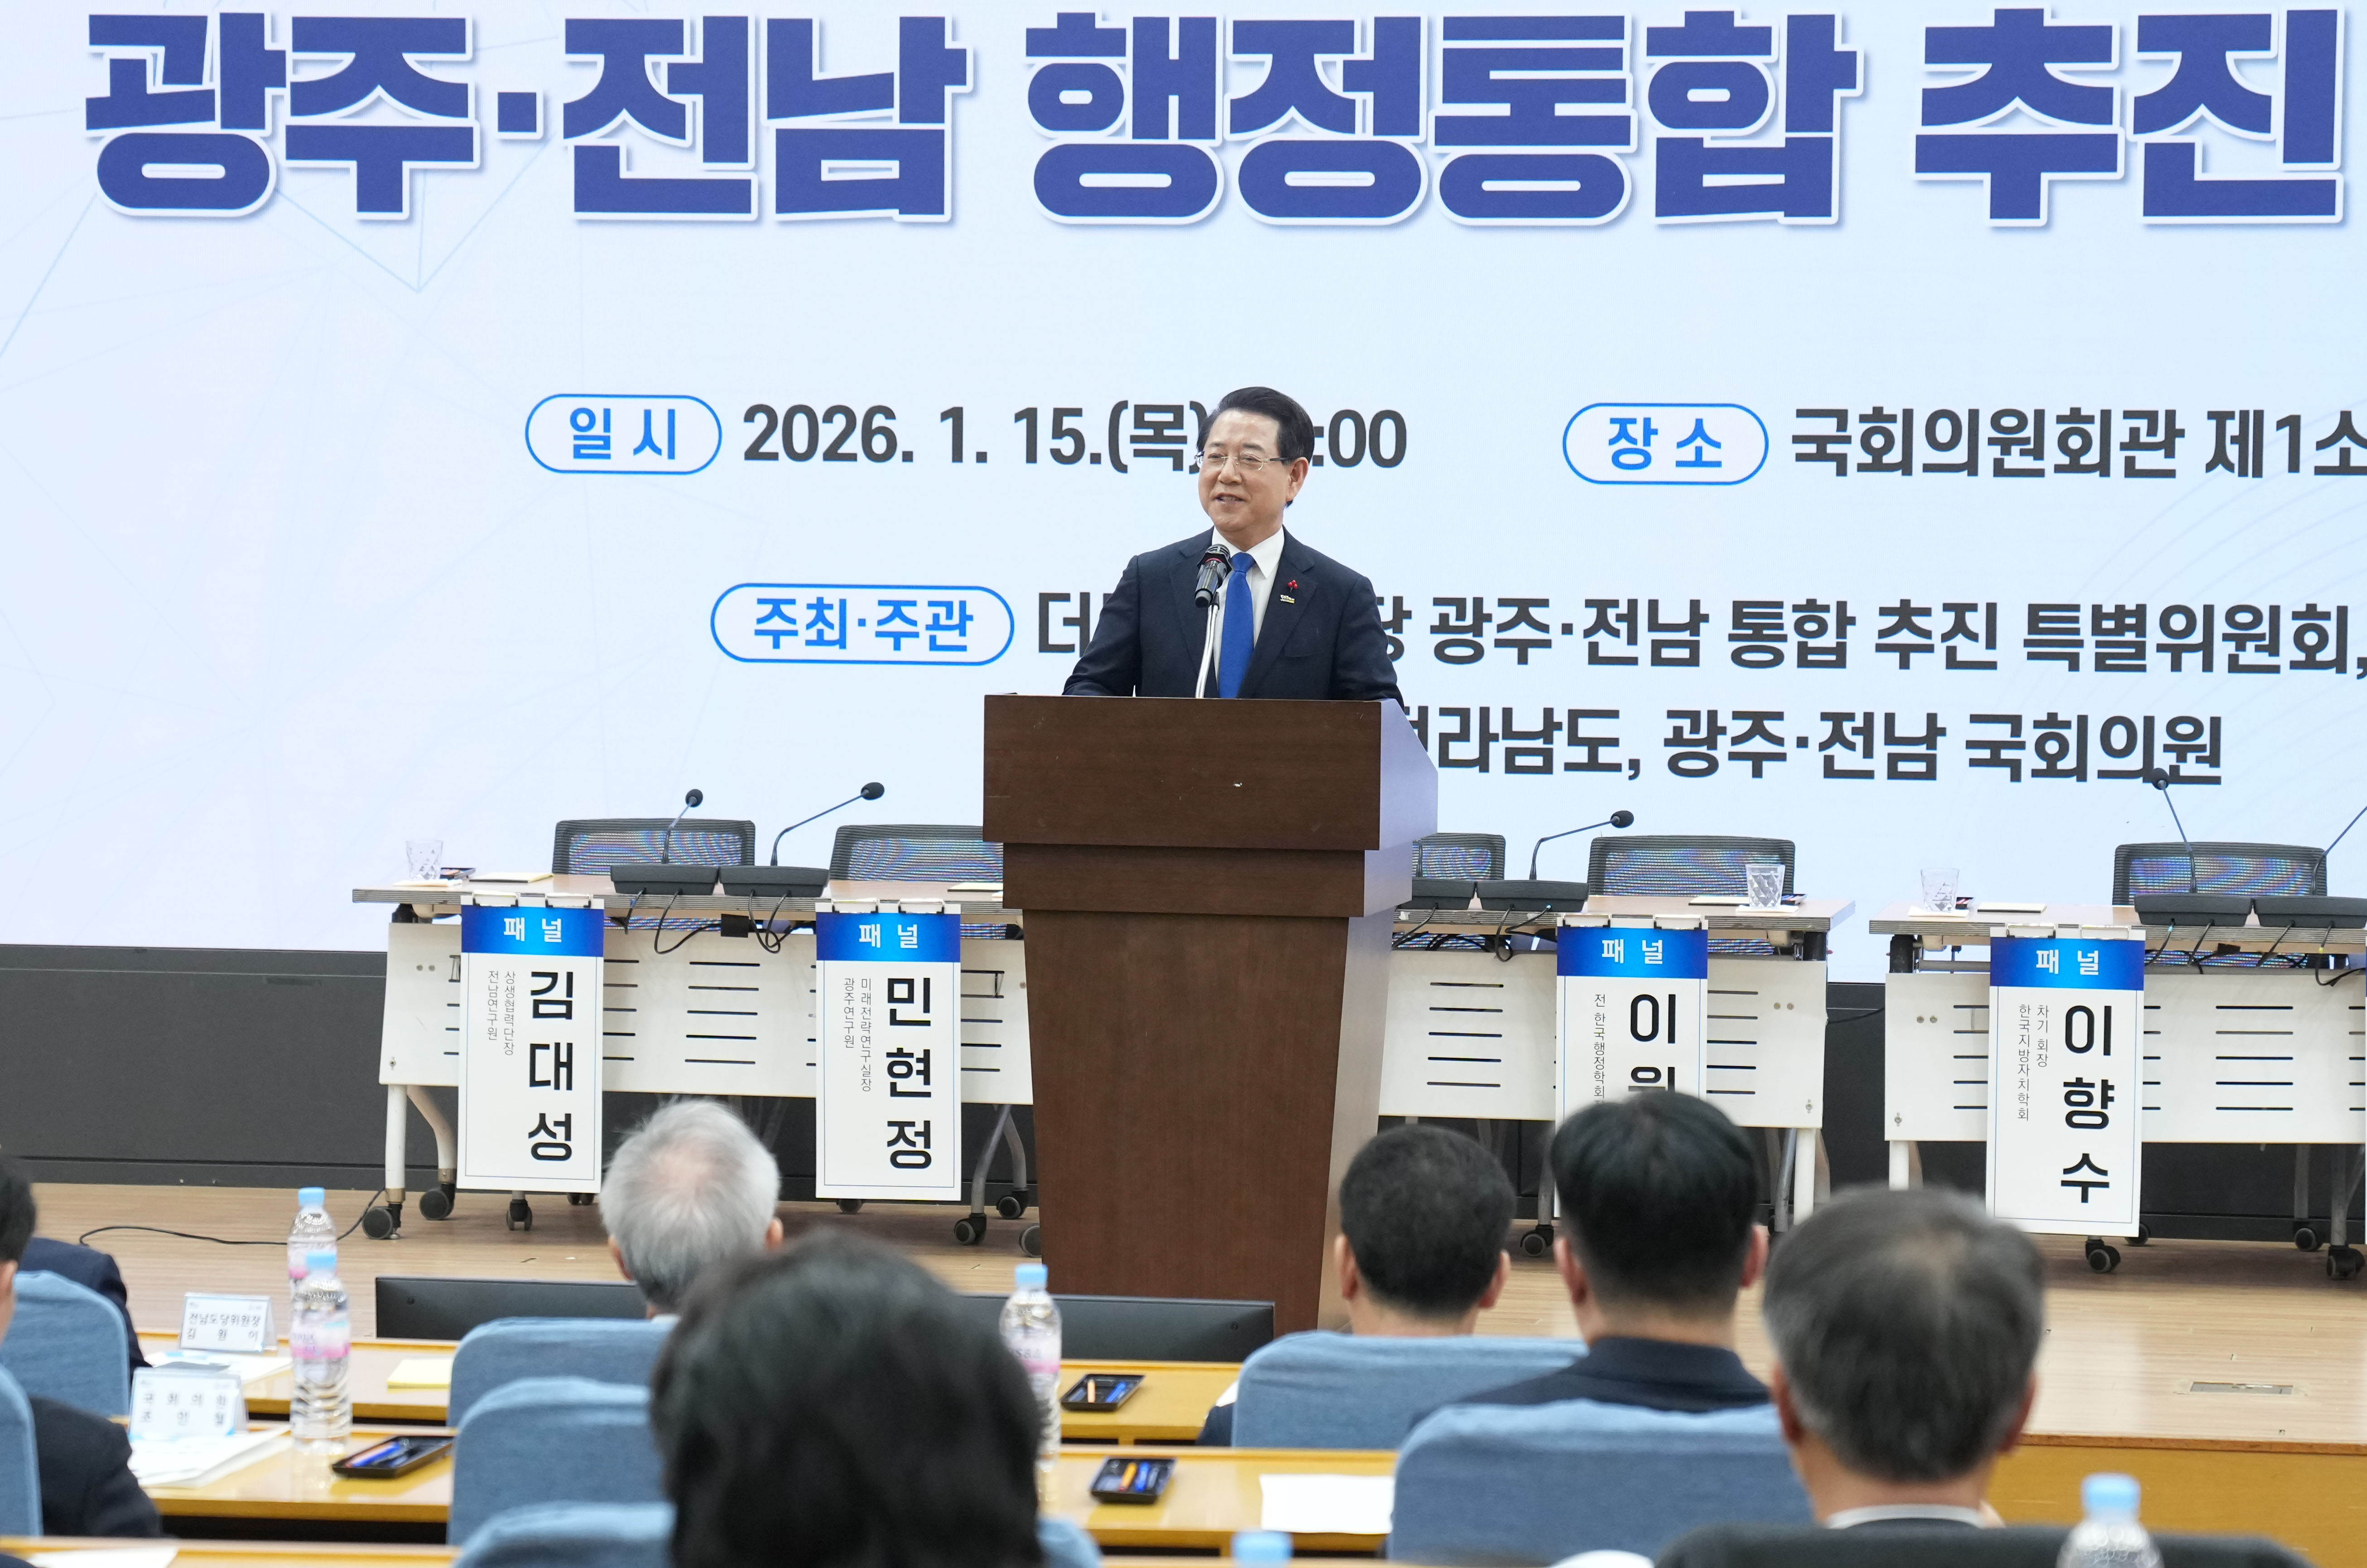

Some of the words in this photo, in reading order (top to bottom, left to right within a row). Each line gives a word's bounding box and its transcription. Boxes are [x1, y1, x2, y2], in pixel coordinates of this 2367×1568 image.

[86, 12, 967, 215] 광주·전남
[1025, 11, 1857, 218] 행정통합
[1915, 9, 2338, 219] 추진
[743, 404, 914, 462] 2026.
[940, 407, 988, 462] 1.
[1791, 406, 2185, 478] 국회의원회관
[754, 596, 974, 653] 주최·주관
[1430, 596, 1710, 667] 광주·전남
[1727, 598, 1857, 669] 통합
[1875, 598, 1998, 670] 추진
[2023, 603, 2367, 679] 특별위원회,
[1663, 709, 1947, 781] 광주·전남
[1965, 712, 2222, 784] 국회의원
[487, 971, 499, 1041] 전남연구원
[504, 971, 516, 1056] 상생협력단장
[843, 978, 855, 1049] 광주연구원
[860, 978, 872, 1092] 미래전략연구실장
[1594, 994, 1606, 1008] 전
[2037, 1005, 2049, 1034] 차기
[1593, 1012, 1606, 1103] 한국행정학회
[2017, 1004, 2031, 1121] 한국지방자치학회
[2036, 1039, 2049, 1068] 회장
